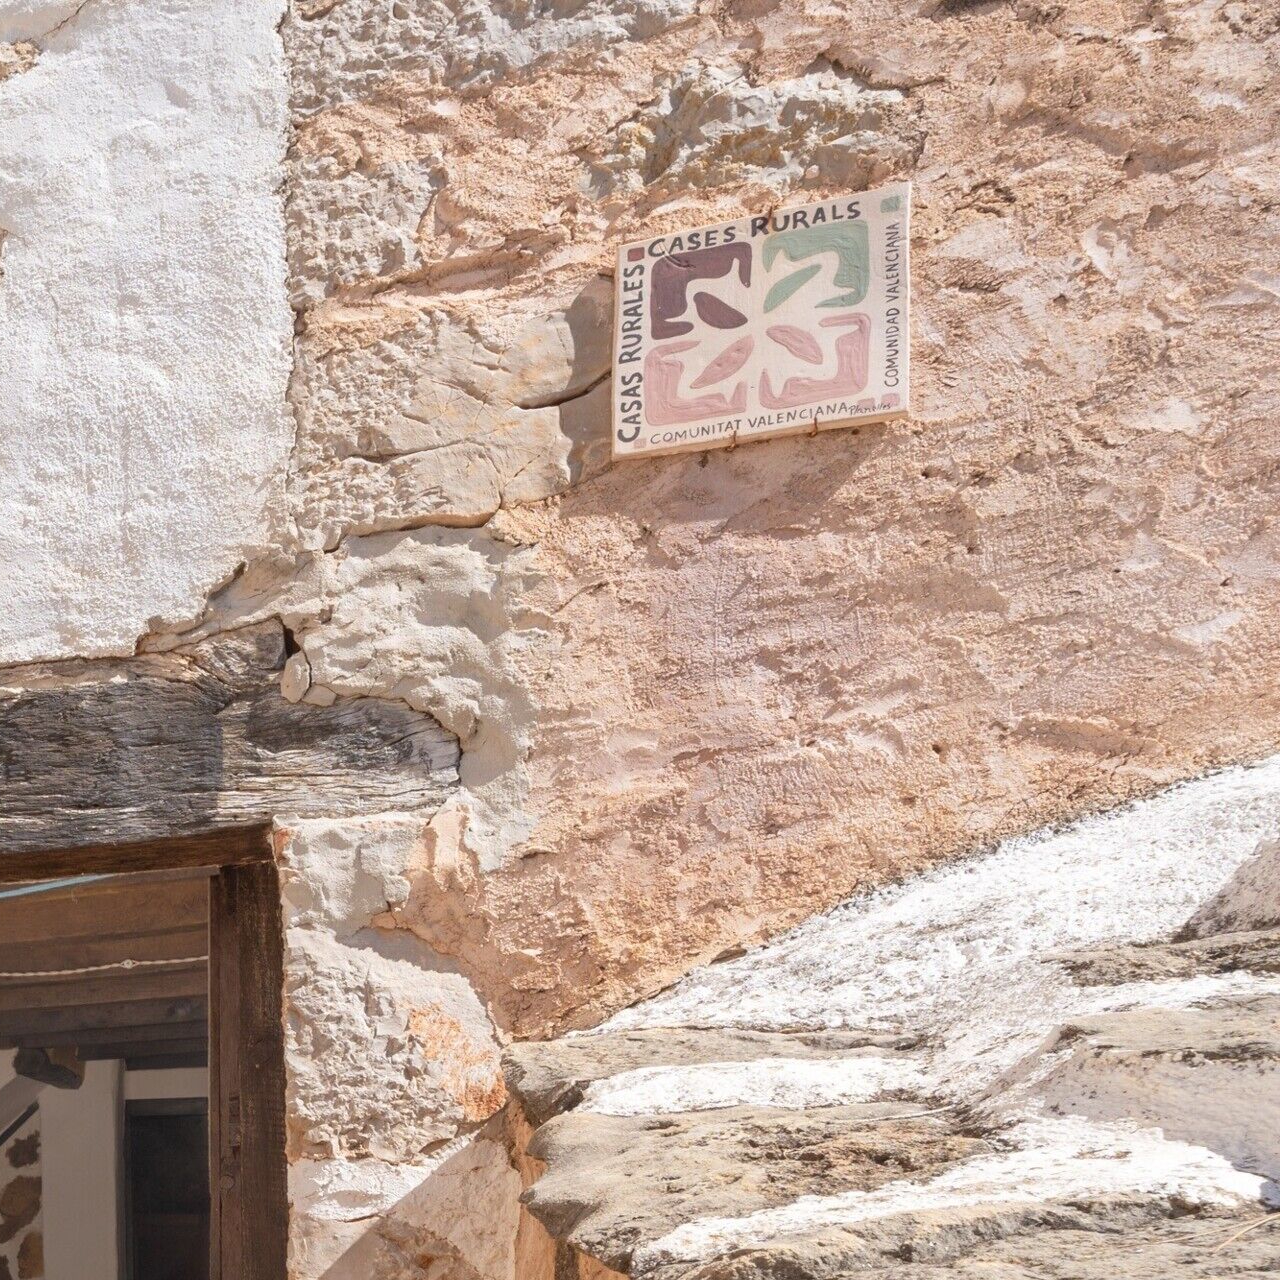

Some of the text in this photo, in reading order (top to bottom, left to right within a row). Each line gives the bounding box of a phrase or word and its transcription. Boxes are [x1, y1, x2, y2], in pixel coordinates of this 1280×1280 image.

[648, 202, 861, 258] CASES RURALS
[618, 264, 645, 443] CASAS RURALES
[885, 222, 900, 388] COMUNIDAD VALENCIANA
[650, 402, 848, 445] COMUNITAT VALENCIANA
